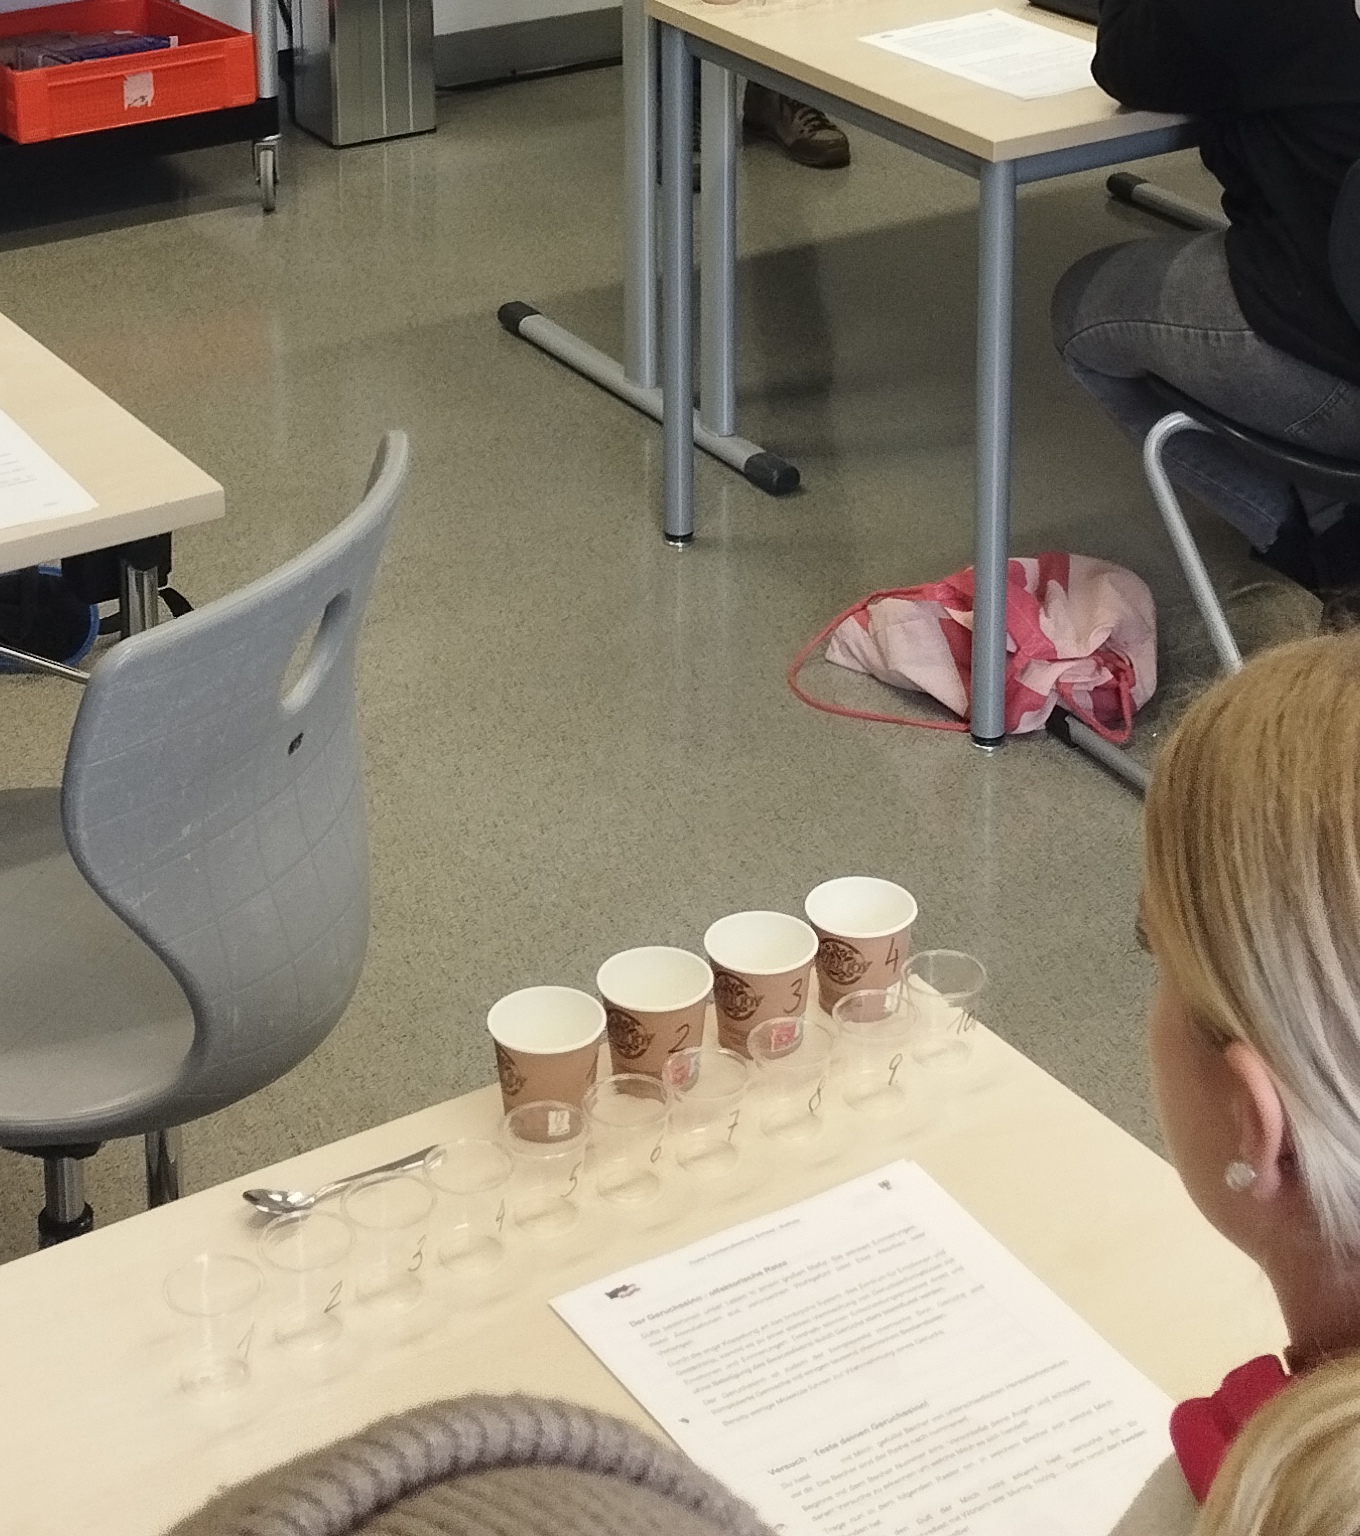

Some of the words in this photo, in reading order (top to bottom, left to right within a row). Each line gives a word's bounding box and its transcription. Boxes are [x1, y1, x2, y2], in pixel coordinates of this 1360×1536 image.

[884, 937, 900, 975] 4
[782, 977, 803, 1015] 3
[667, 1023, 691, 1055] 2
[559, 1160, 583, 1199] 5
[323, 1279, 344, 1315] 2
